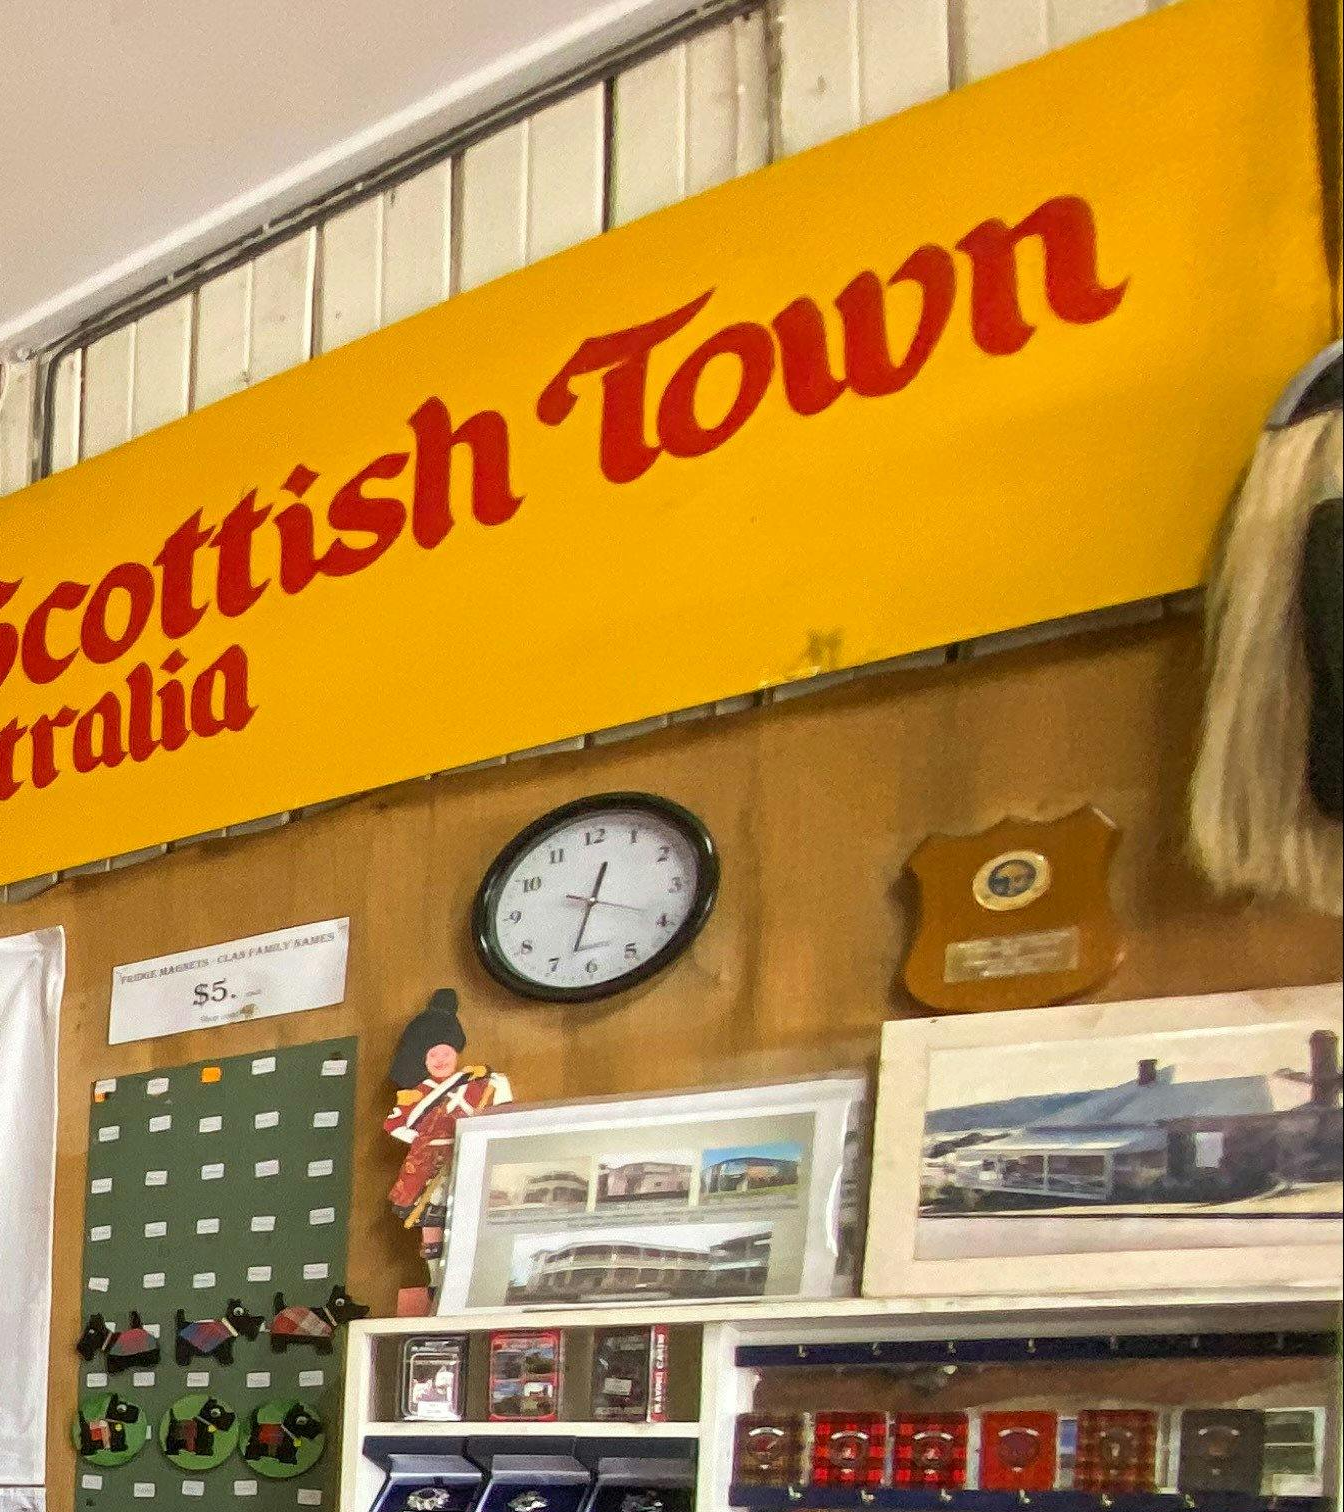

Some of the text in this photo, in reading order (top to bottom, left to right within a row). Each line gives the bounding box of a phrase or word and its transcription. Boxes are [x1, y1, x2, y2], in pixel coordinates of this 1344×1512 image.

[535, 195, 1129, 485] Town
[584, 828, 606, 846] 12
[630, 829, 638, 844] 1
[549, 848, 564, 864] 11
[657, 846, 670, 863] 2
[523, 876, 542, 892] 10
[669, 876, 683, 893] 3
[509, 910, 522, 924] 9
[121, 969, 158, 984] FRIDGE
[159, 958, 209, 978] MAGNETS
[247, 940, 292, 958] FAMILY
[293, 932, 335, 950] NAMES
[548, 957, 559, 972] 7
[585, 961, 598, 973] 6
